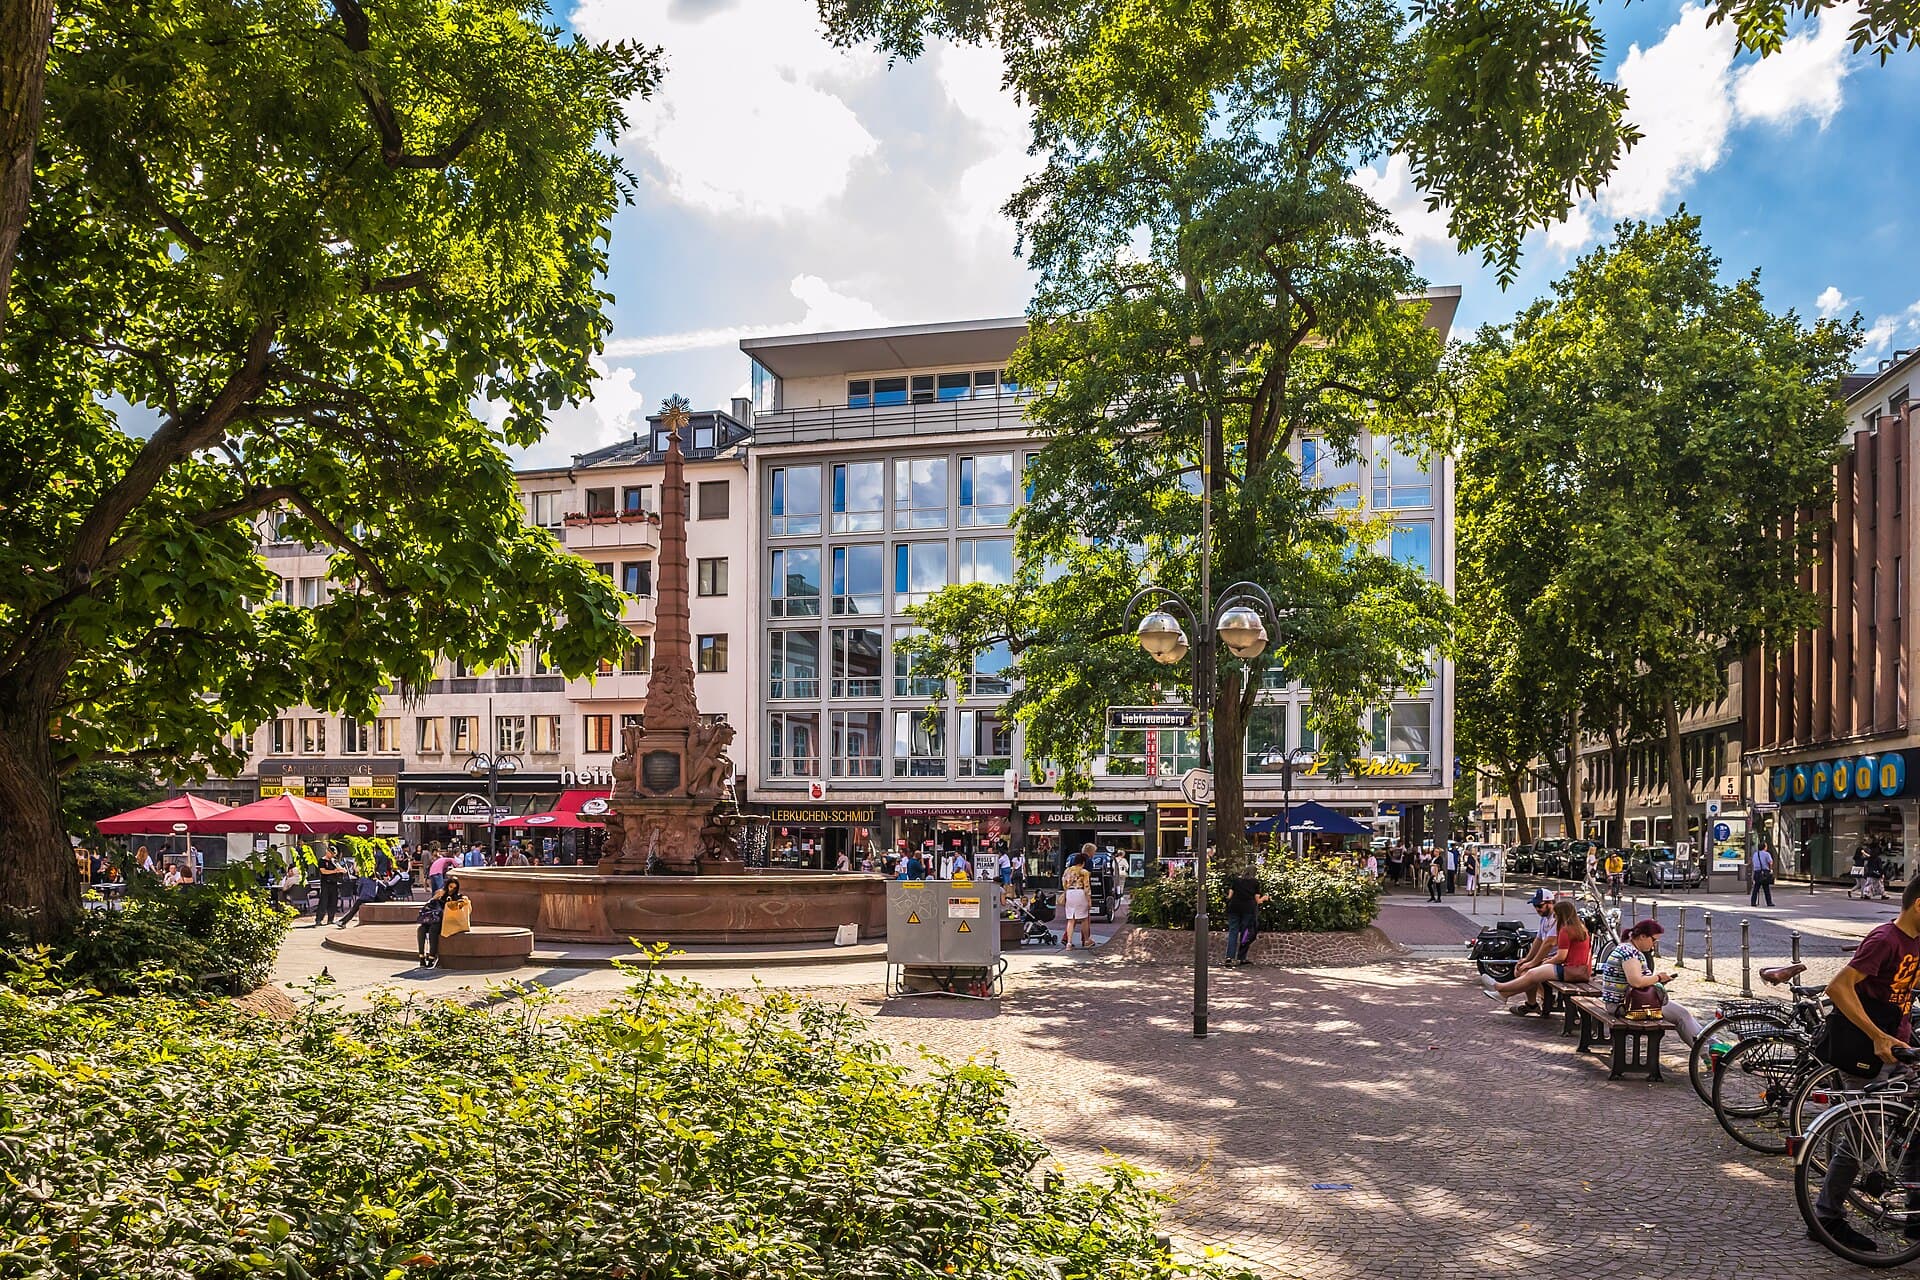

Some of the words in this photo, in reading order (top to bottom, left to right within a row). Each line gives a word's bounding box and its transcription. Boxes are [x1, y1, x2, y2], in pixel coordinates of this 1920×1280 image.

[1121, 713, 1185, 726] Liebfrauenberg
[1193, 778, 1206, 790] FES
[1774, 763, 1897, 797] Jordan
[771, 809, 876, 822] LEBKUCHEN-SCHMIDT
[1047, 813, 1075, 822] ADLER
